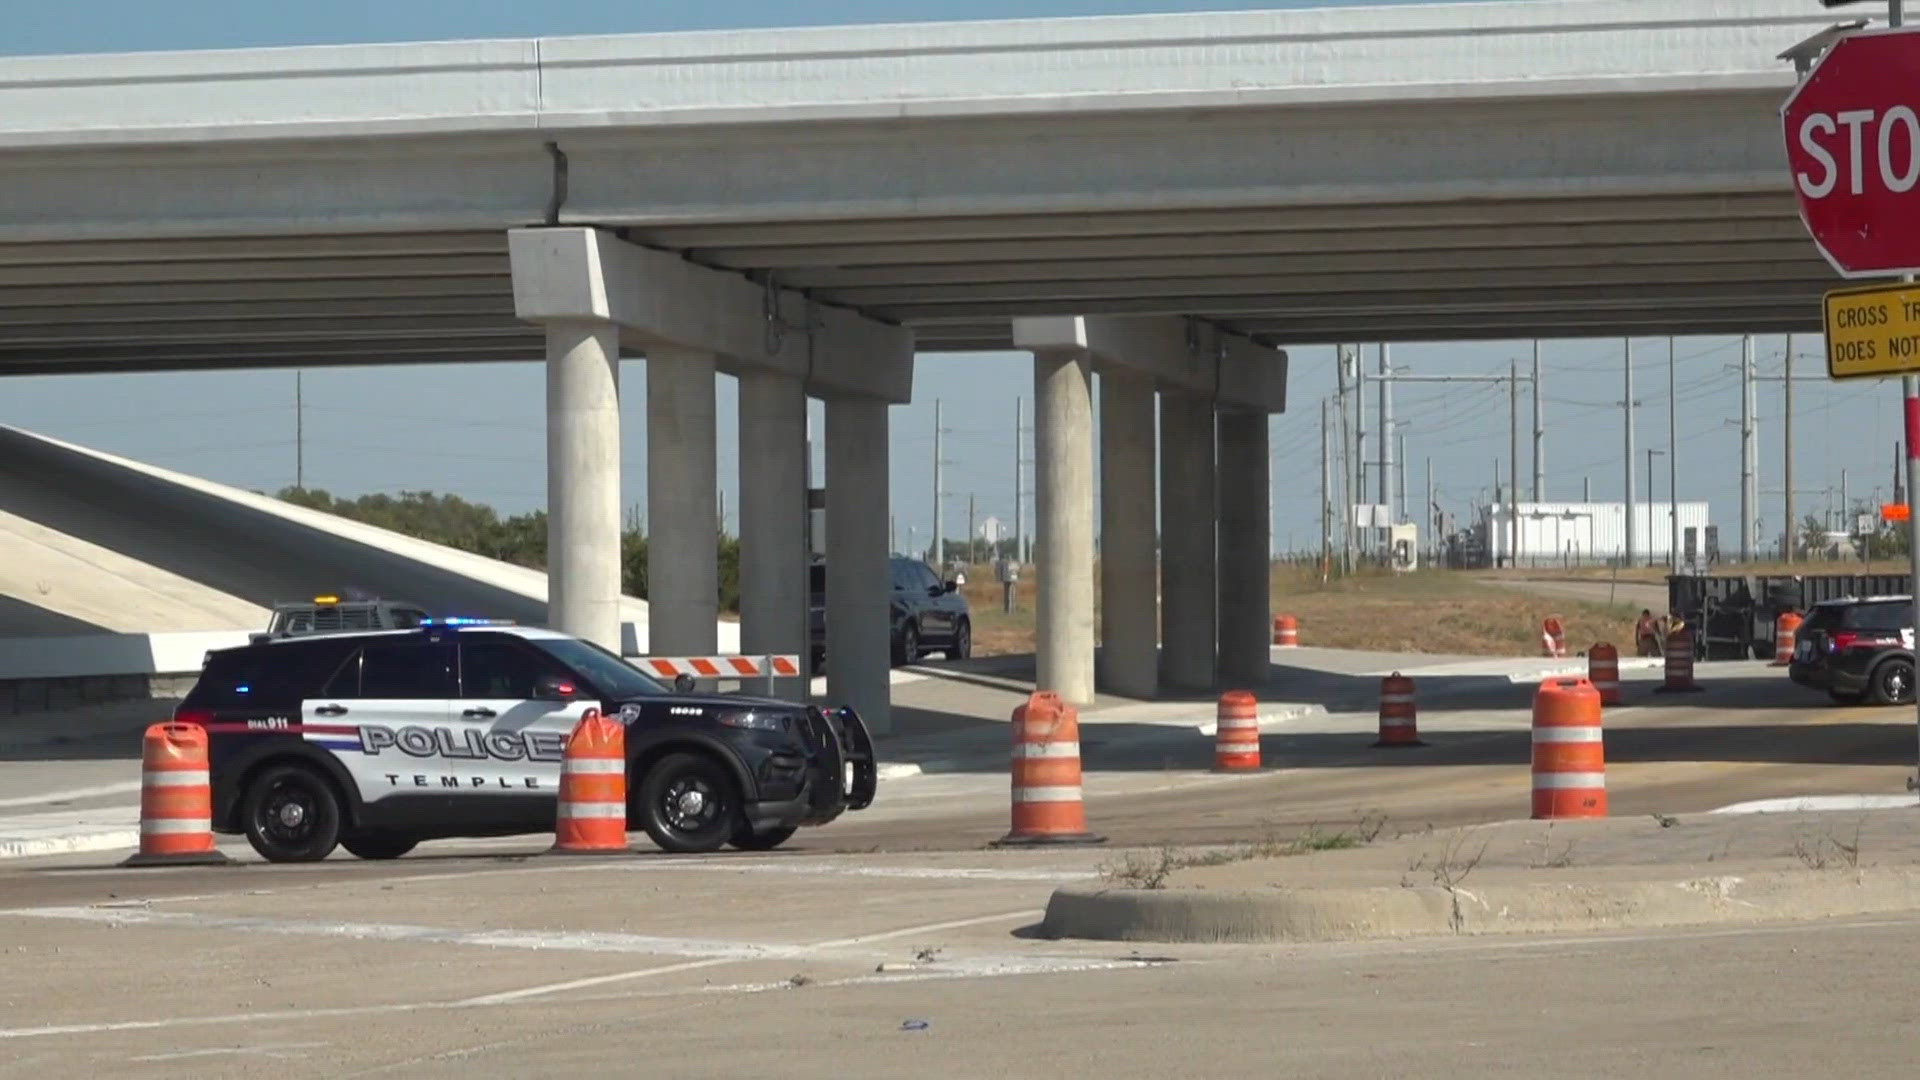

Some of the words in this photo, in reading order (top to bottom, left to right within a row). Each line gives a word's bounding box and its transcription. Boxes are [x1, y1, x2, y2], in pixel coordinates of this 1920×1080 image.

[1837, 304, 1888, 328] CROSS
[1835, 339, 1876, 362] DOES
[1889, 335, 1920, 358] NOT
[267, 716, 288, 729] 911
[358, 725, 563, 762] POLICE
[385, 774, 540, 789] TEMPLE
